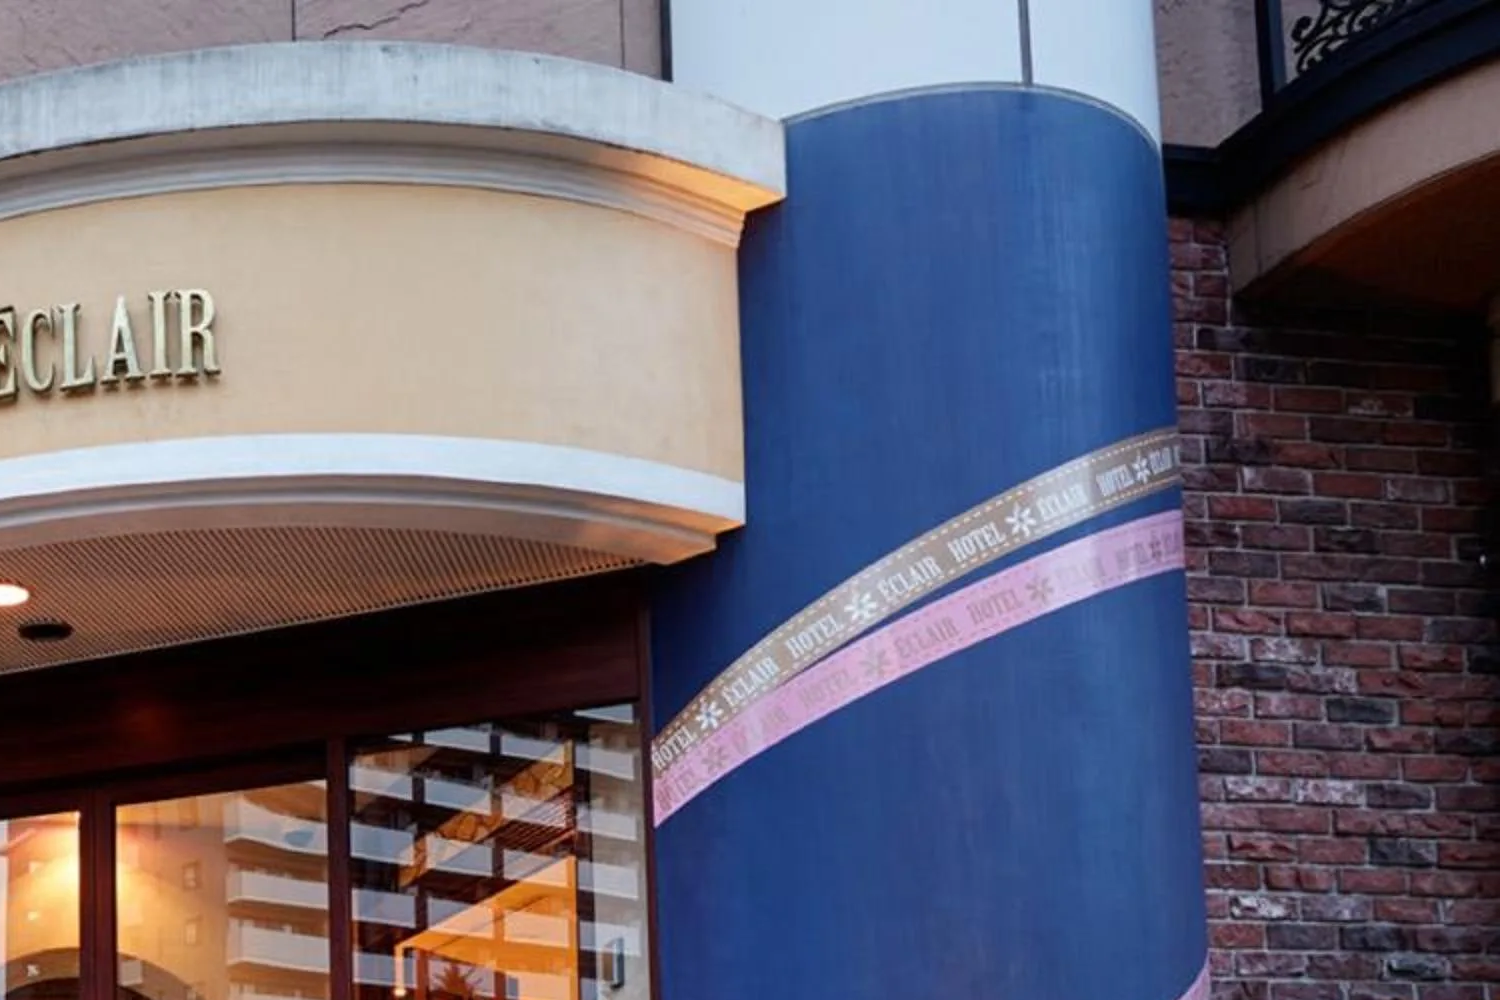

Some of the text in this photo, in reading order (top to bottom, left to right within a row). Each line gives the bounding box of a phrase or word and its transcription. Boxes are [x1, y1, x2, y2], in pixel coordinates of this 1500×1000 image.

[651, 726, 697, 771] HOTEL
[785, 613, 844, 659] HOTEL
[947, 522, 1007, 563] HOTEL
[966, 588, 1025, 626] HOTEL
